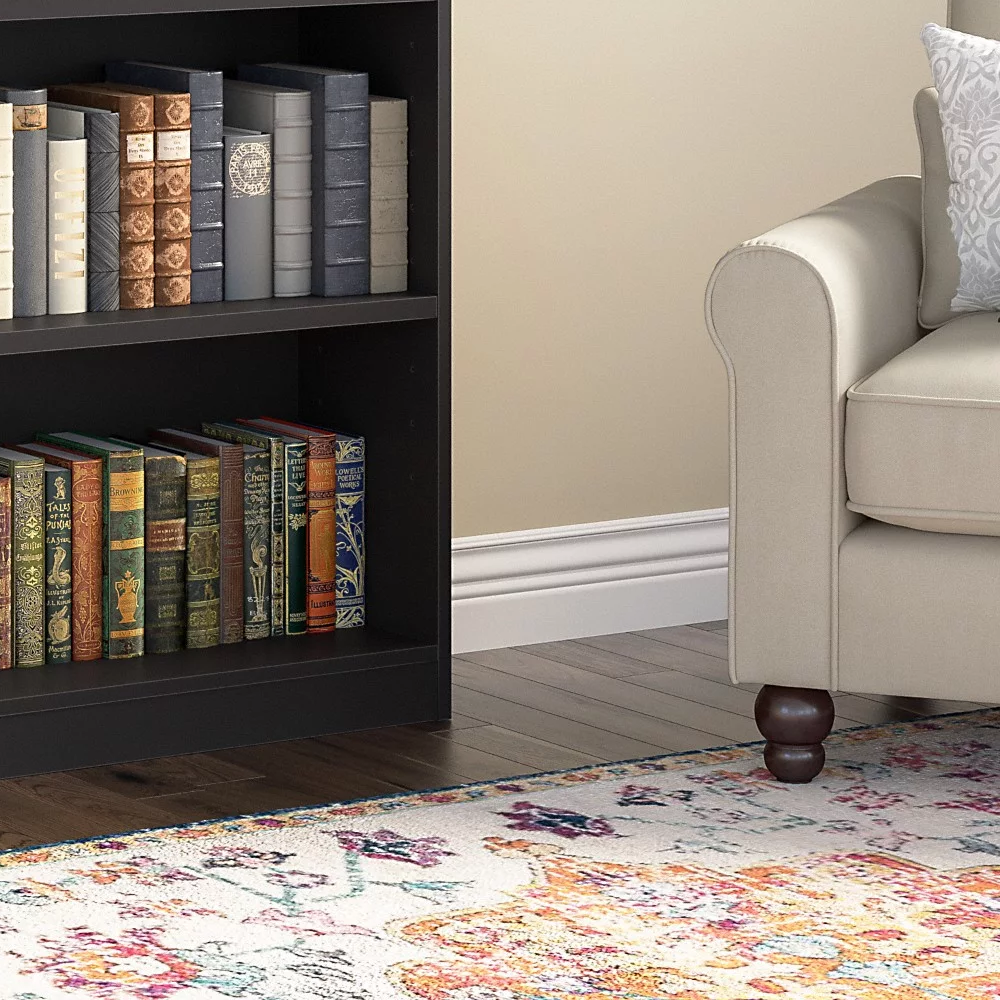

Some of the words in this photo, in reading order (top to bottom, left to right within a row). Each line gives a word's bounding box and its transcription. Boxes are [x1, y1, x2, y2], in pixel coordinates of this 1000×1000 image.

[53, 168, 85, 279] UFFIZI
[339, 480, 360, 489] WORKS
[46, 501, 71, 512] TALES
